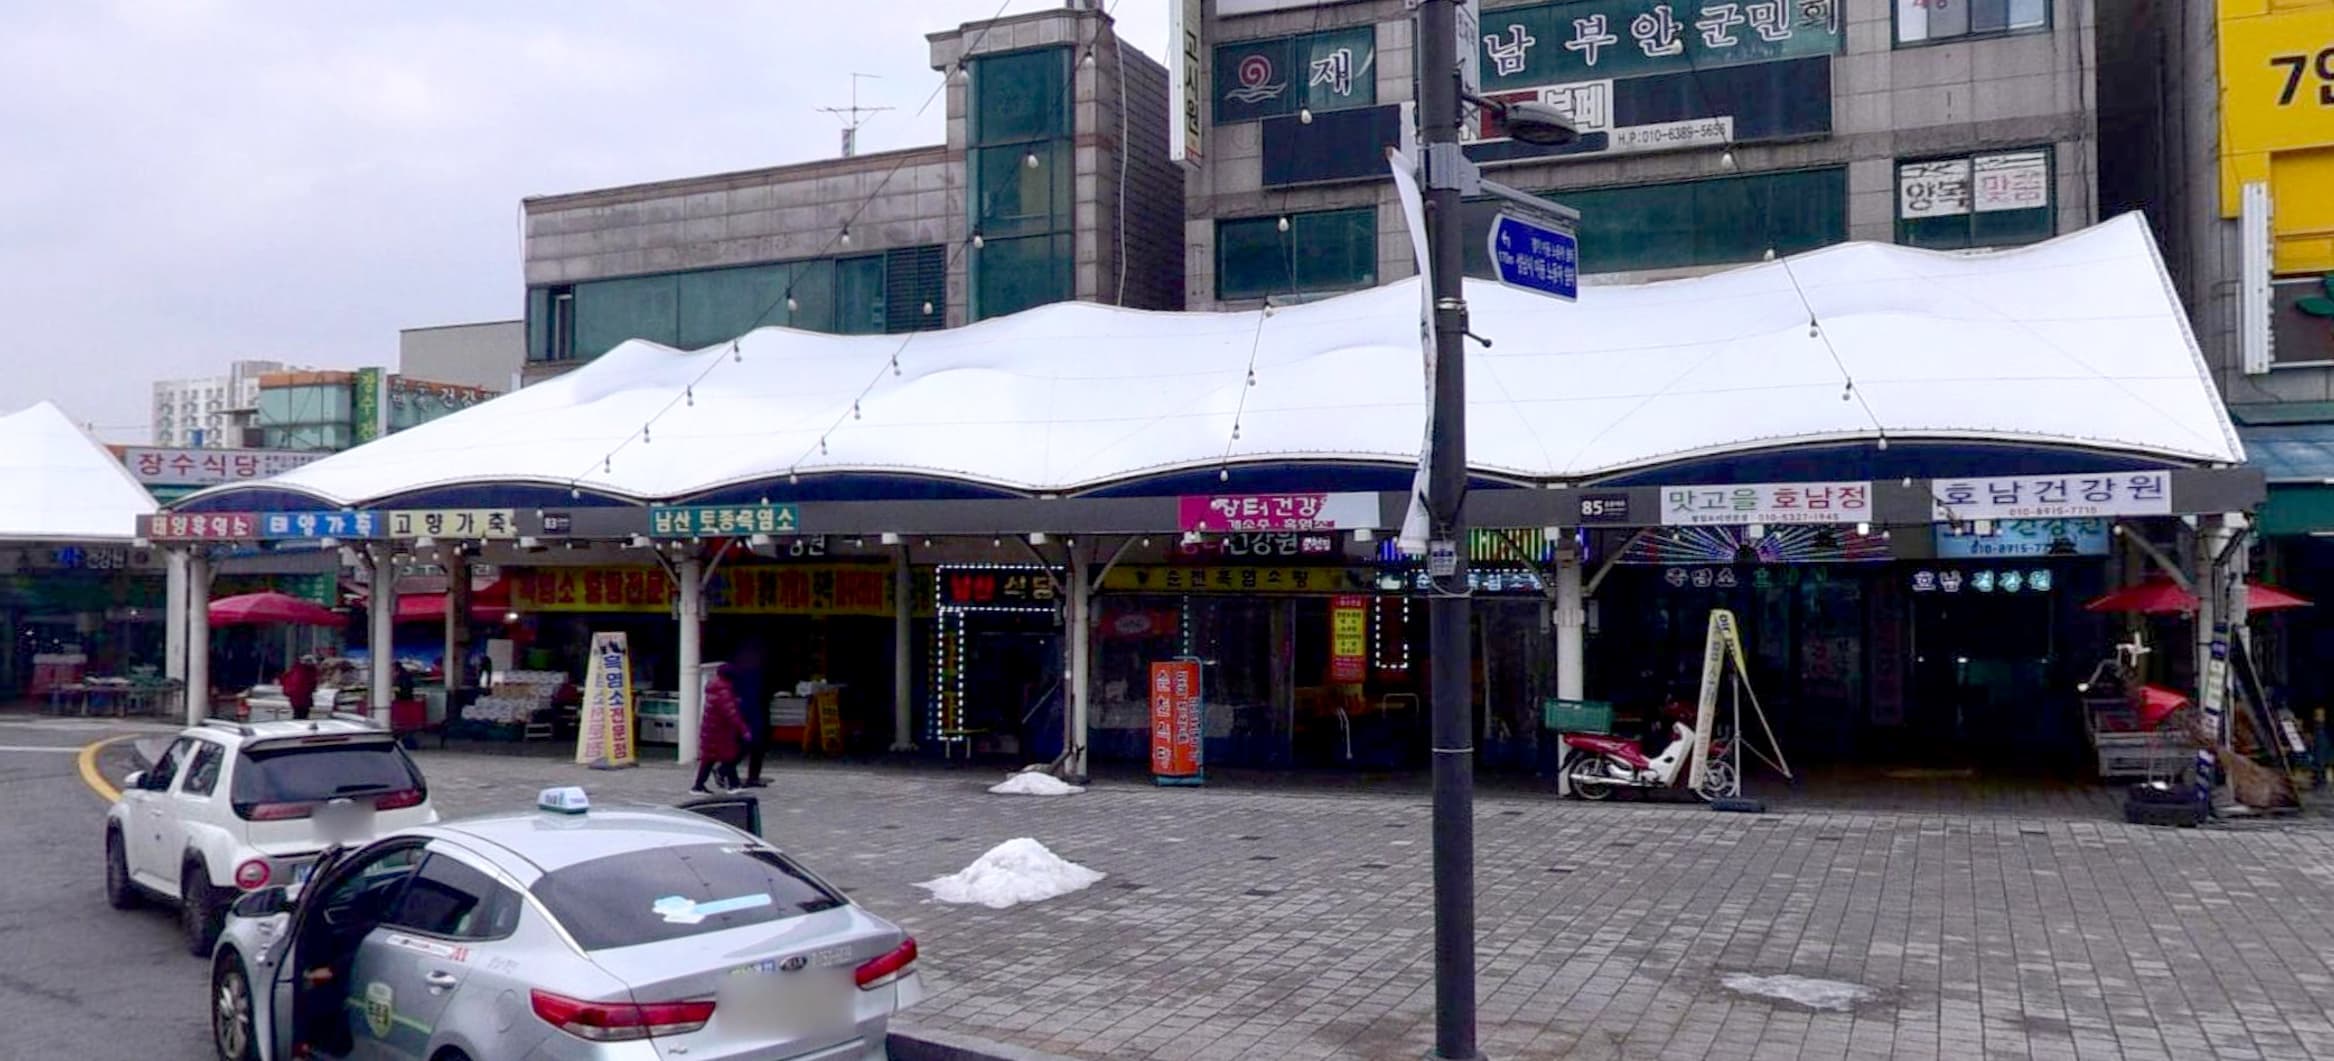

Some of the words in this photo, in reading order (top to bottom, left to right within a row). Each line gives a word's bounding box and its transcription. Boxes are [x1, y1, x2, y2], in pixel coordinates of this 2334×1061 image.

[1483, 24, 1536, 76] 남
[138, 452, 260, 477] 장수식당
[1668, 487, 1759, 512] 맛고을
[1771, 485, 1866, 510] 호남정
[1944, 475, 2164, 505] 호남건강원
[1213, 497, 1268, 518] 장터
[1581, 500, 1604, 516] 85
[394, 512, 506, 535] 고향가축
[655, 511, 691, 533] 남산
[1911, 570, 1963, 593] 호남
